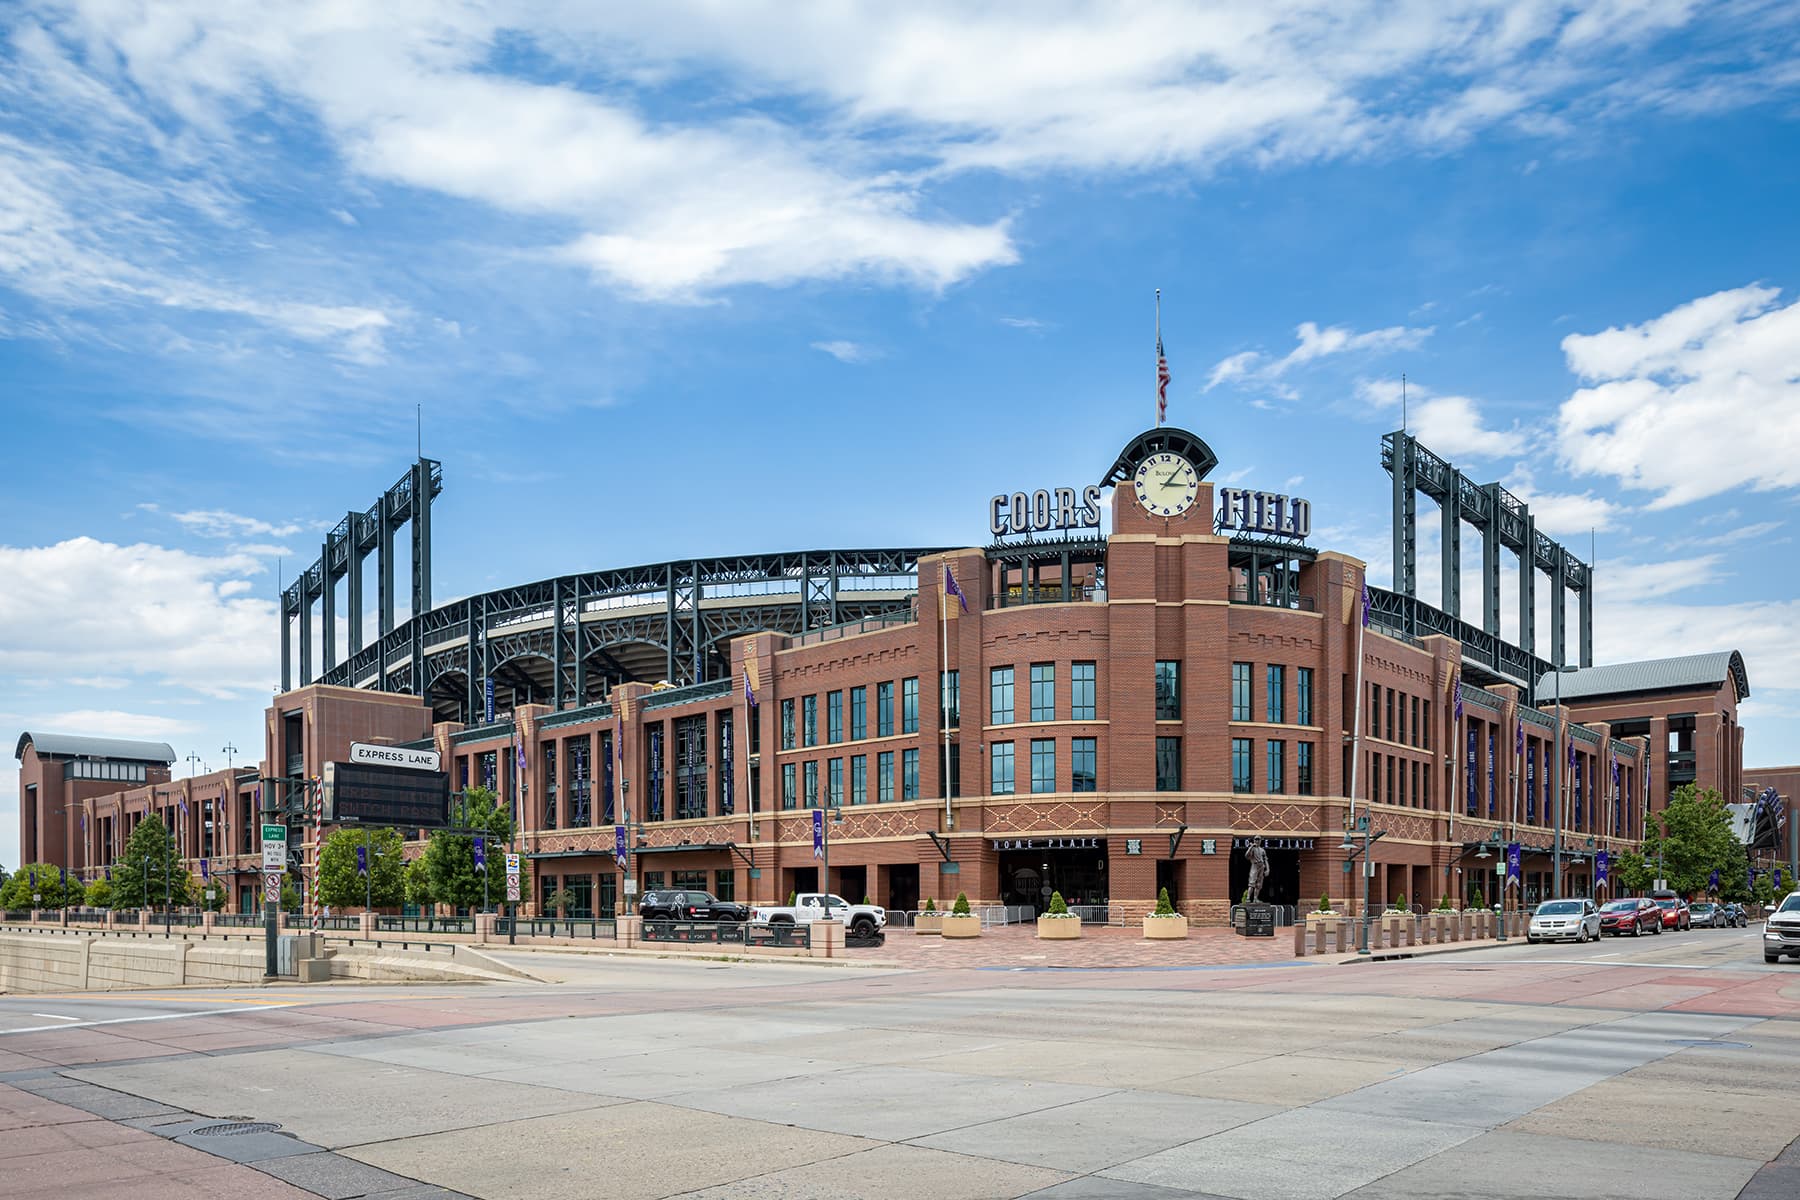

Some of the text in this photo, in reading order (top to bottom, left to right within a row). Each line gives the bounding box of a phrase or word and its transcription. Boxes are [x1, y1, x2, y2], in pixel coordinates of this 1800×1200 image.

[1139, 466, 1147, 475] 10
[990, 485, 1100, 535] COORS
[1220, 488, 1311, 538] FIELD
[358, 749, 433, 765] EXPRESS LANE
[993, 838, 1097, 849] HOME PLATE
[1234, 839, 1314, 849] HOE PLATE
